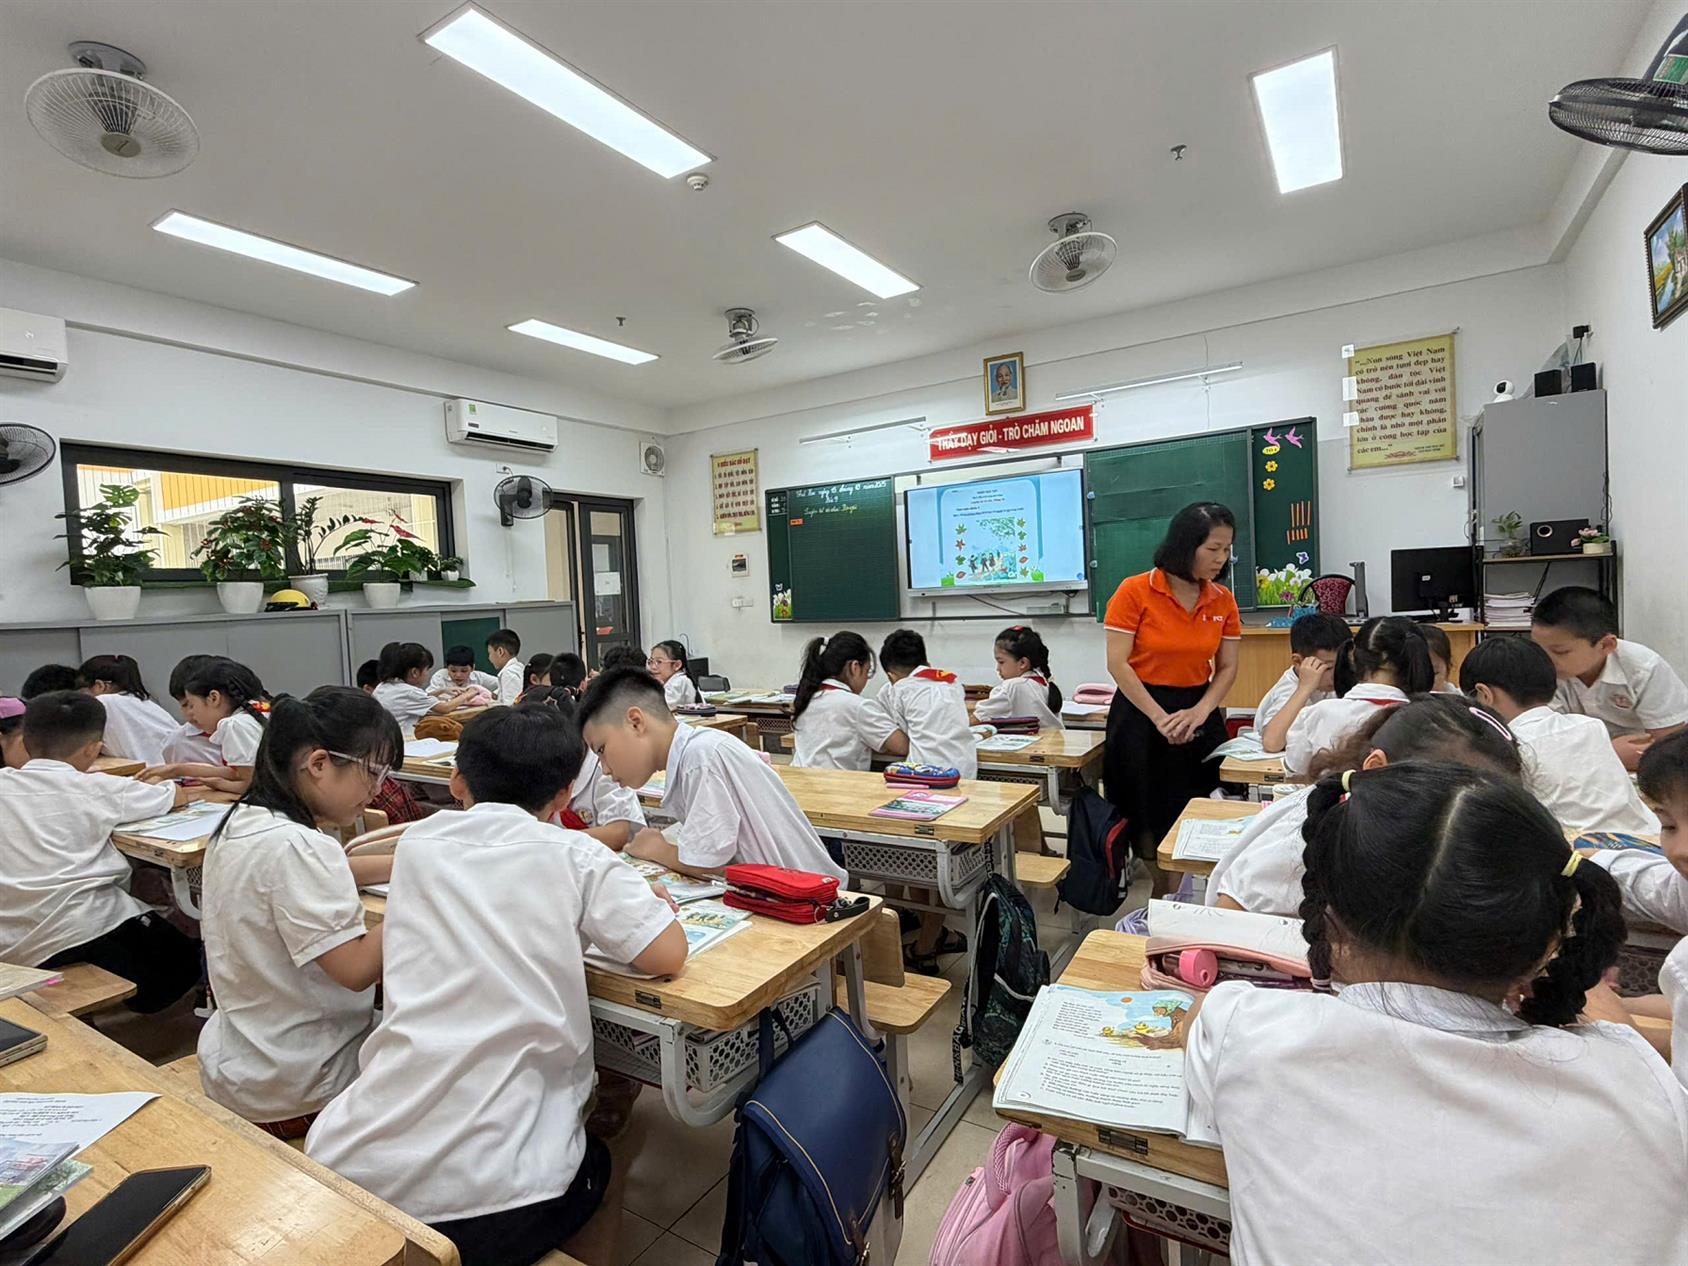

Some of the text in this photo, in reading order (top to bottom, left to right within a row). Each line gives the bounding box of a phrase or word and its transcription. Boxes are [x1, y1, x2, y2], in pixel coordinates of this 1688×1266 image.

[1427, 347, 1445, 355] Nam
[980, 424, 998, 444] GIỎI
[1003, 422, 1021, 440] TRÒ
[1022, 419, 1049, 439] CHĂM
[1051, 415, 1085, 435] NGOAN
